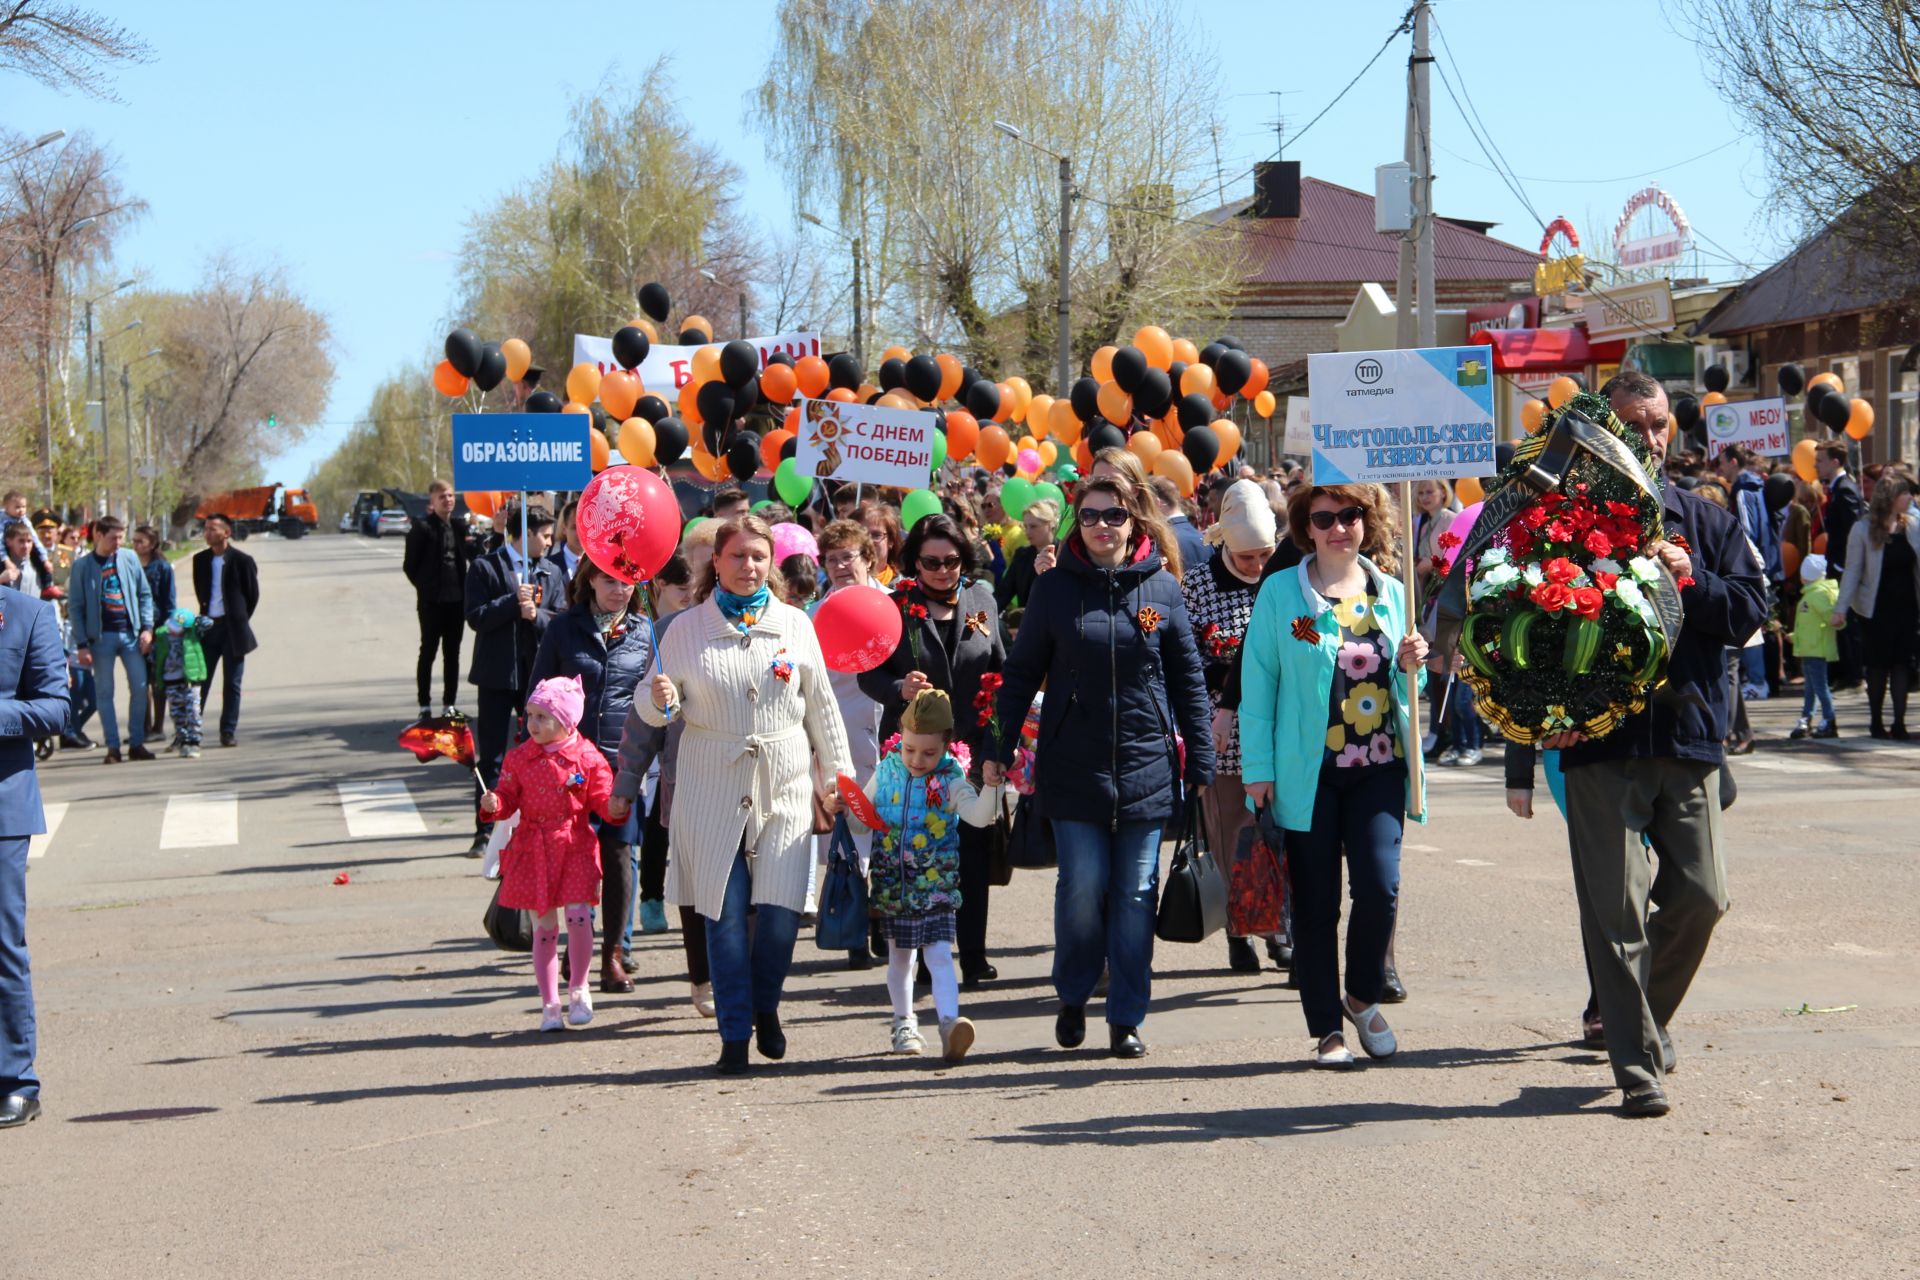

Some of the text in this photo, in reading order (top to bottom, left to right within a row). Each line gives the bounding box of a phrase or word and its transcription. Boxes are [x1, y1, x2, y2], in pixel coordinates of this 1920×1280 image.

[1601, 295, 1657, 326] ПРОДУКТЫ
[1346, 387, 1394, 397] татмедиа
[1749, 408, 1781, 426] МБОУ
[856, 422, 868, 436] С
[1312, 422, 1493, 449] Чистопольские
[1768, 432, 1786, 449] №1
[462, 441, 583, 463] ОБРАЗОВАНИЕ
[847, 444, 929, 467] ПОБЕДЫ!
[1366, 443, 1494, 468] ИЗВЕСТИЯ
[1357, 472, 1381, 480] Газета
[1382, 471, 1415, 479] основана
[1423, 469, 1438, 477] 1918
[1439, 470, 1456, 478] году
[583, 503, 602, 539] 9
